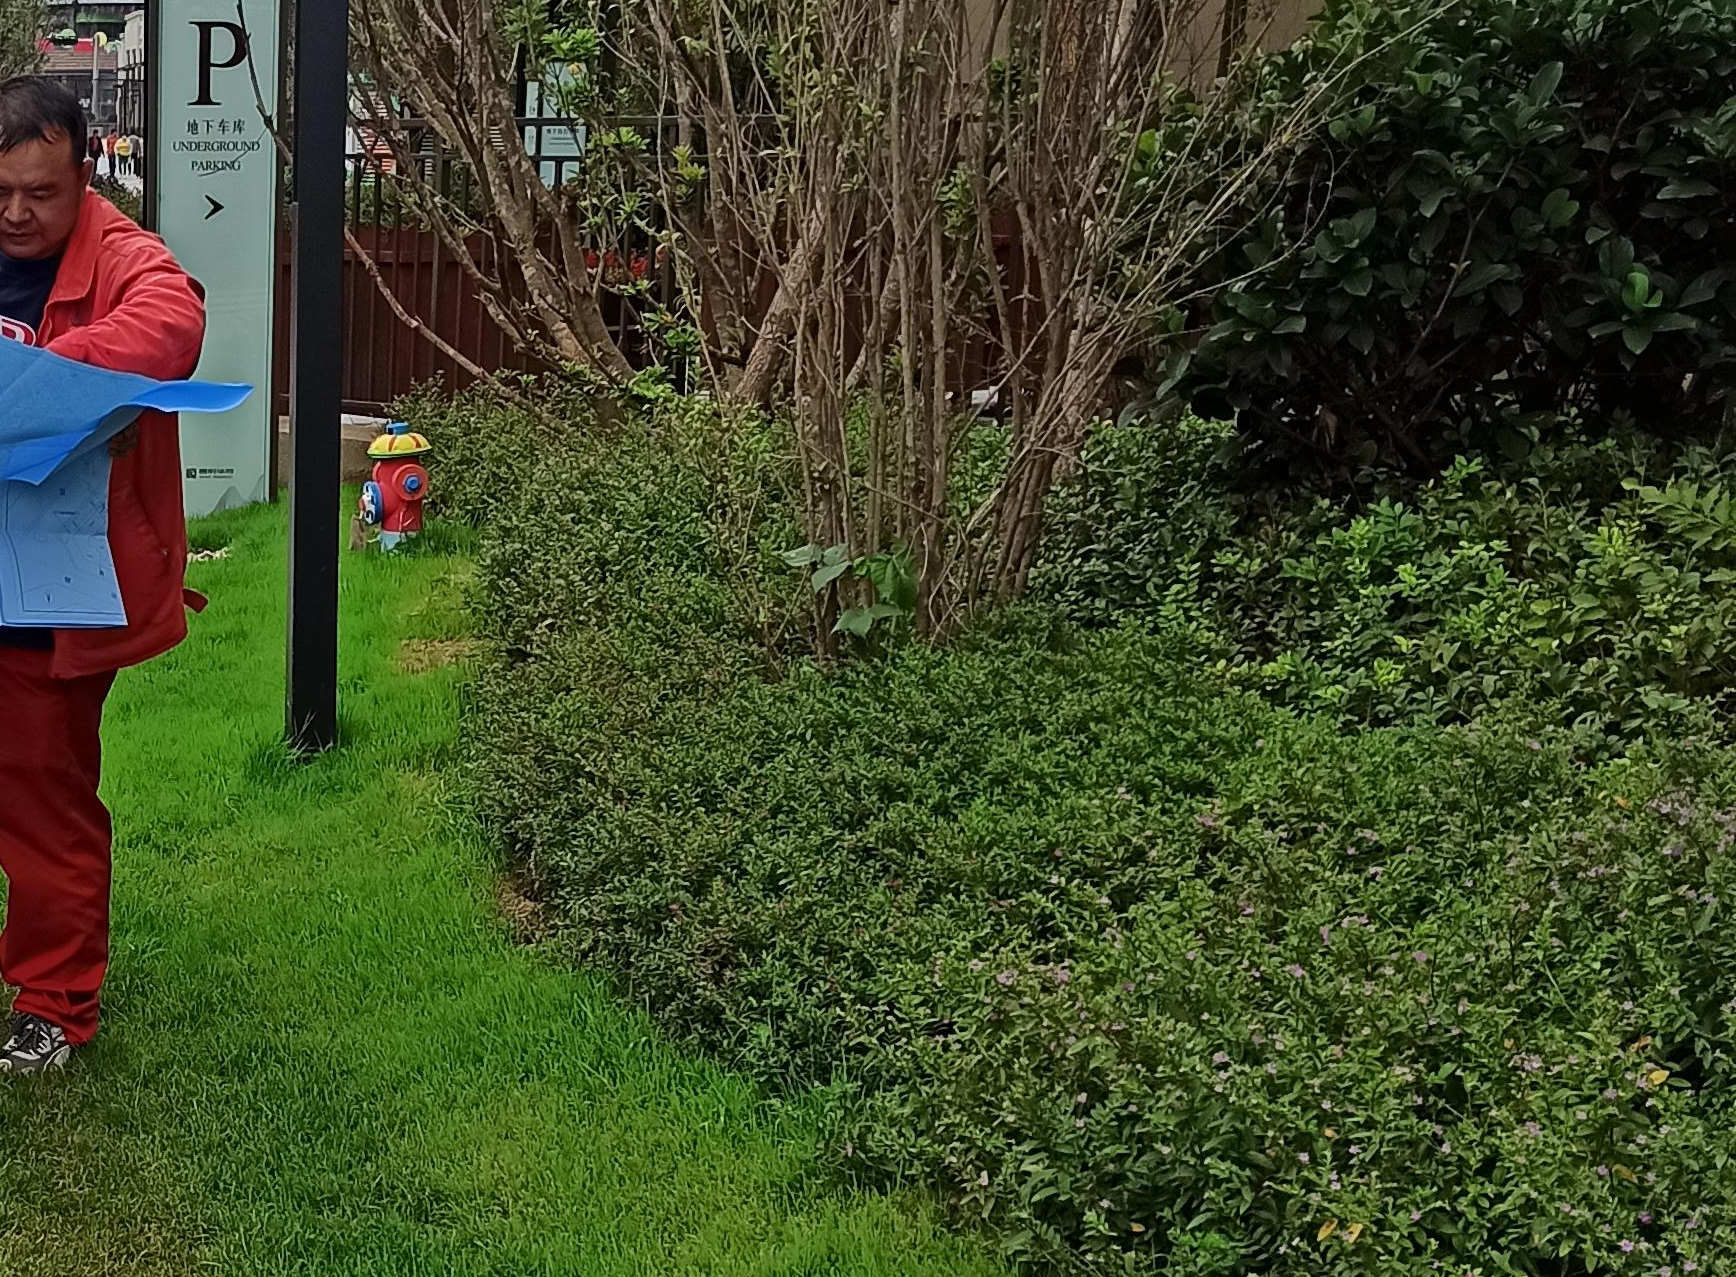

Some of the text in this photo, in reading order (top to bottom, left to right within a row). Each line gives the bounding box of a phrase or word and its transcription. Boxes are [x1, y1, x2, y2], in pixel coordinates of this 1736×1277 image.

[187, 21, 248, 106] P
[187, 119, 246, 135] 地下车库
[172, 140, 261, 152] UNDERGROUND
[191, 160, 241, 172] PARKING
